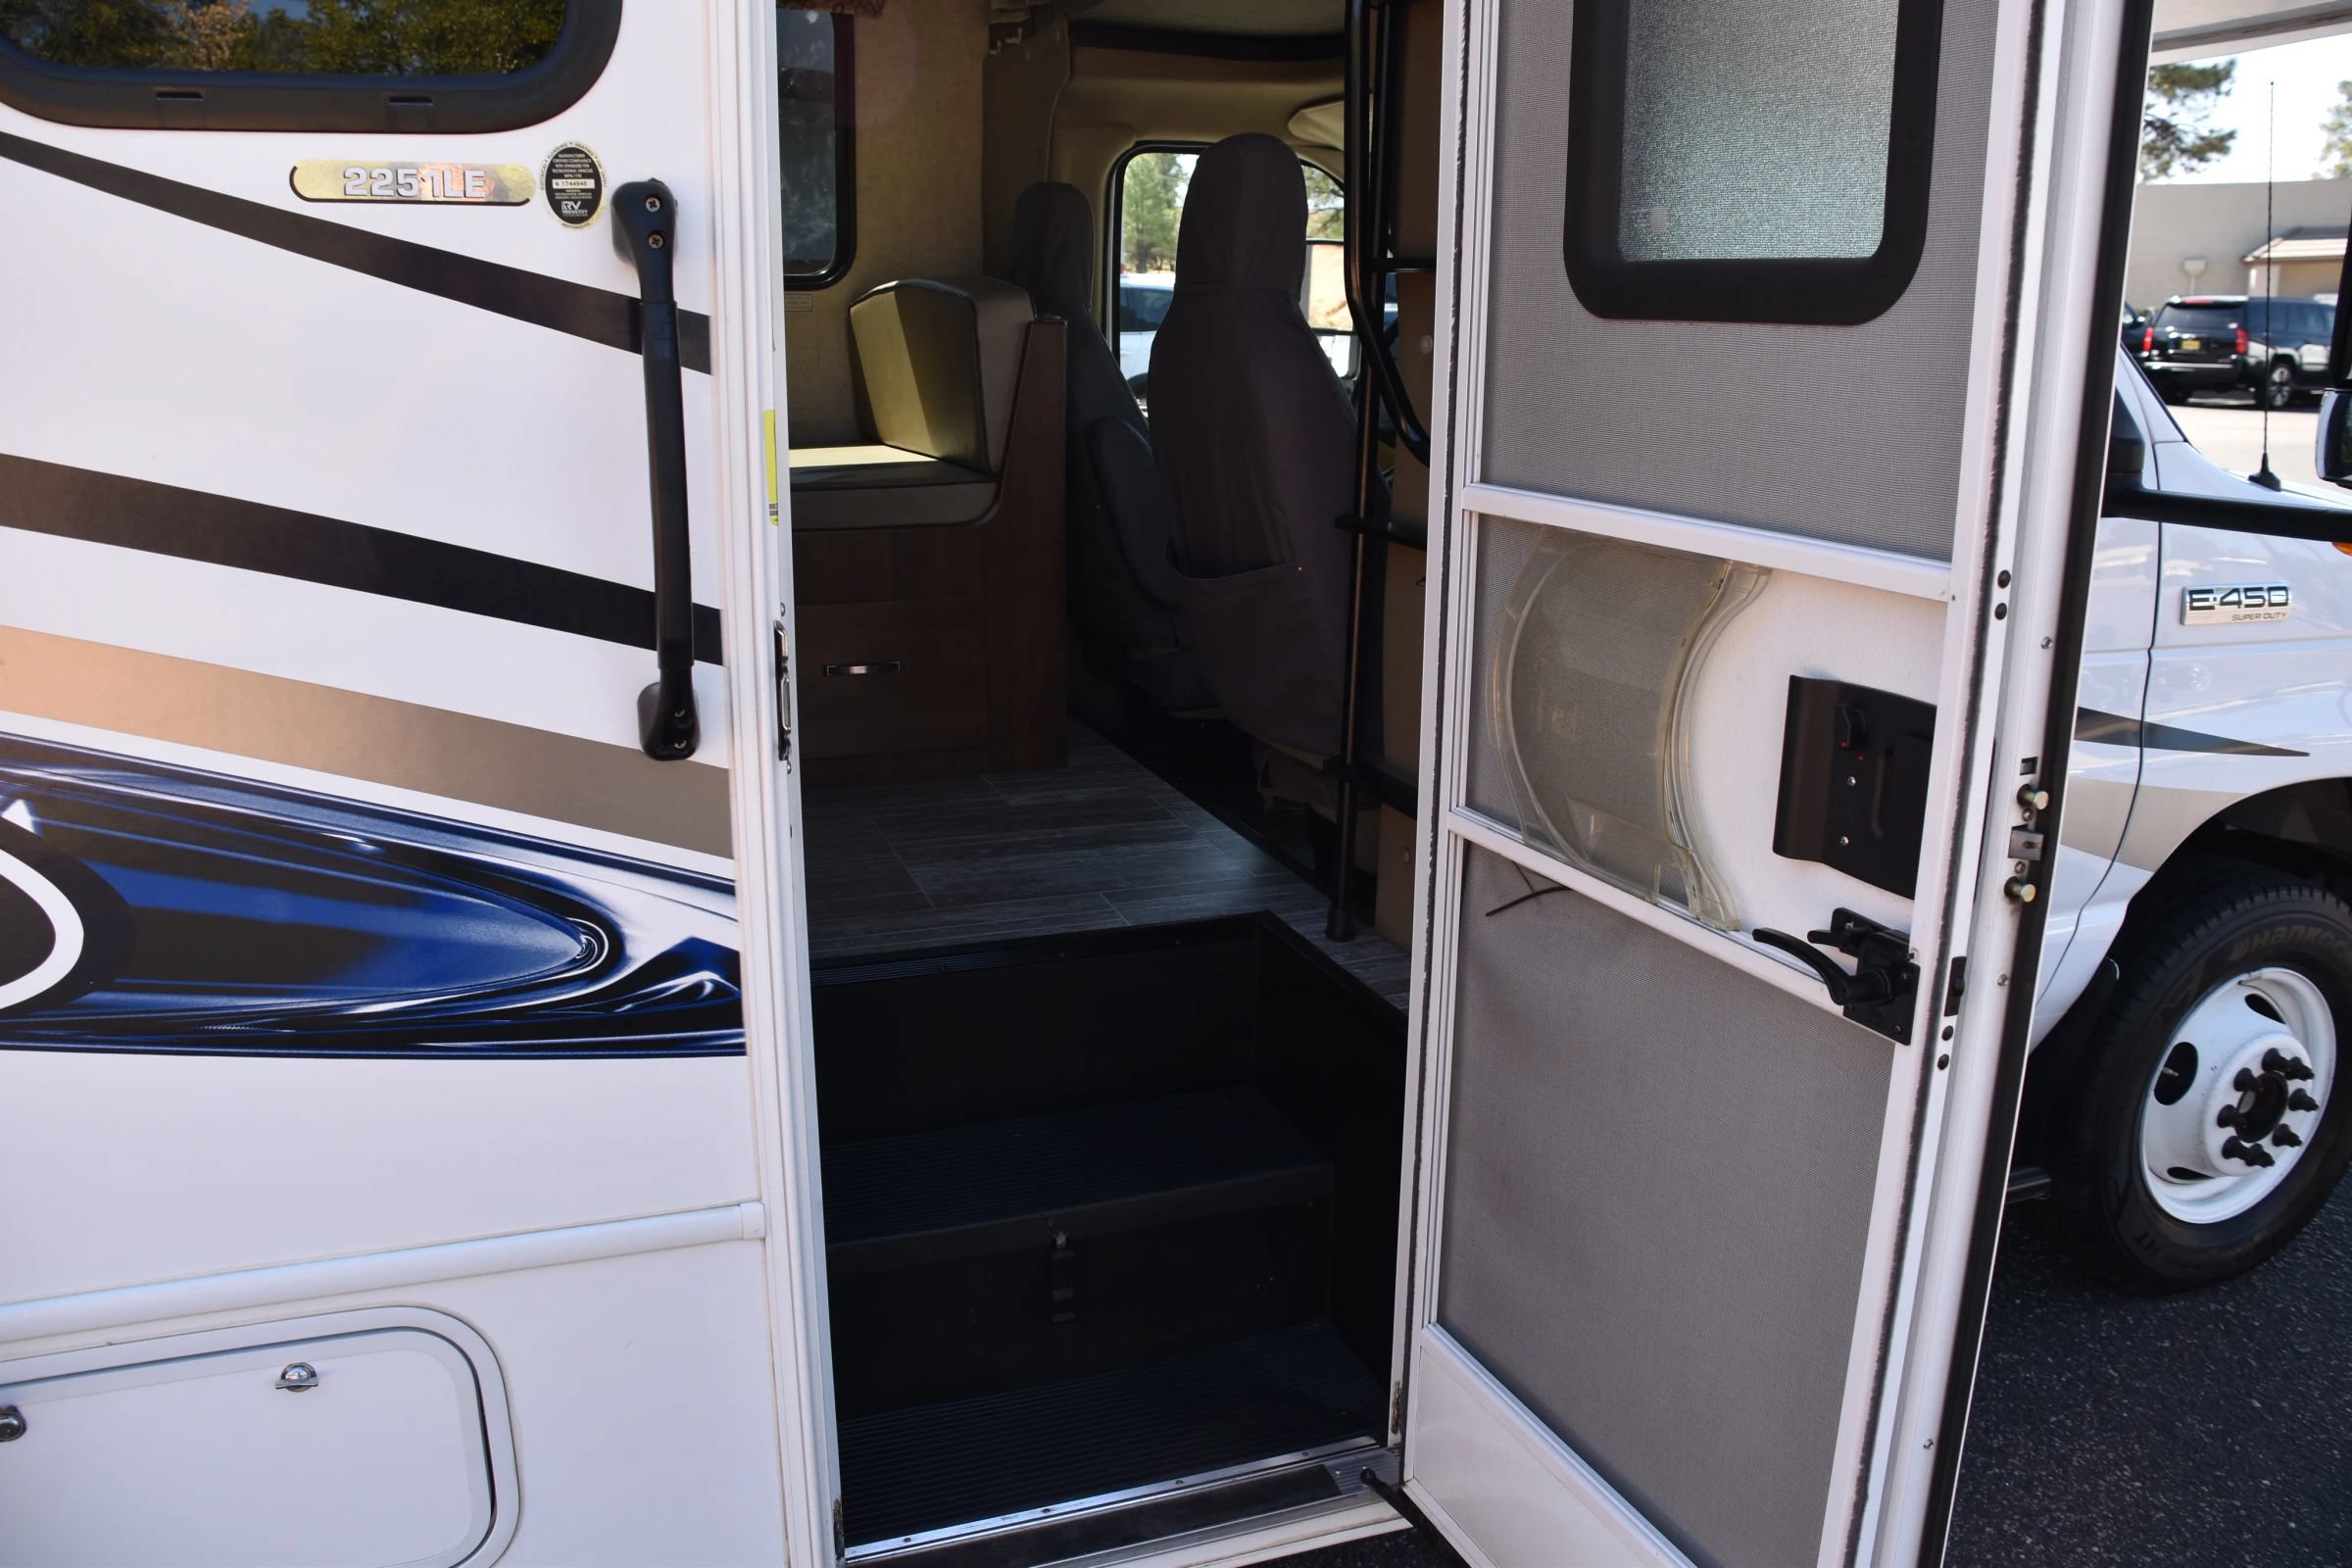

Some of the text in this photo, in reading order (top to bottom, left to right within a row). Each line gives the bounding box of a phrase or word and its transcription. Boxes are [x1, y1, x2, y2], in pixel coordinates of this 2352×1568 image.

[343, 167, 486, 198] 2251LE
[562, 200, 582, 211] RV
[2231, 612, 2262, 621] SUPER
